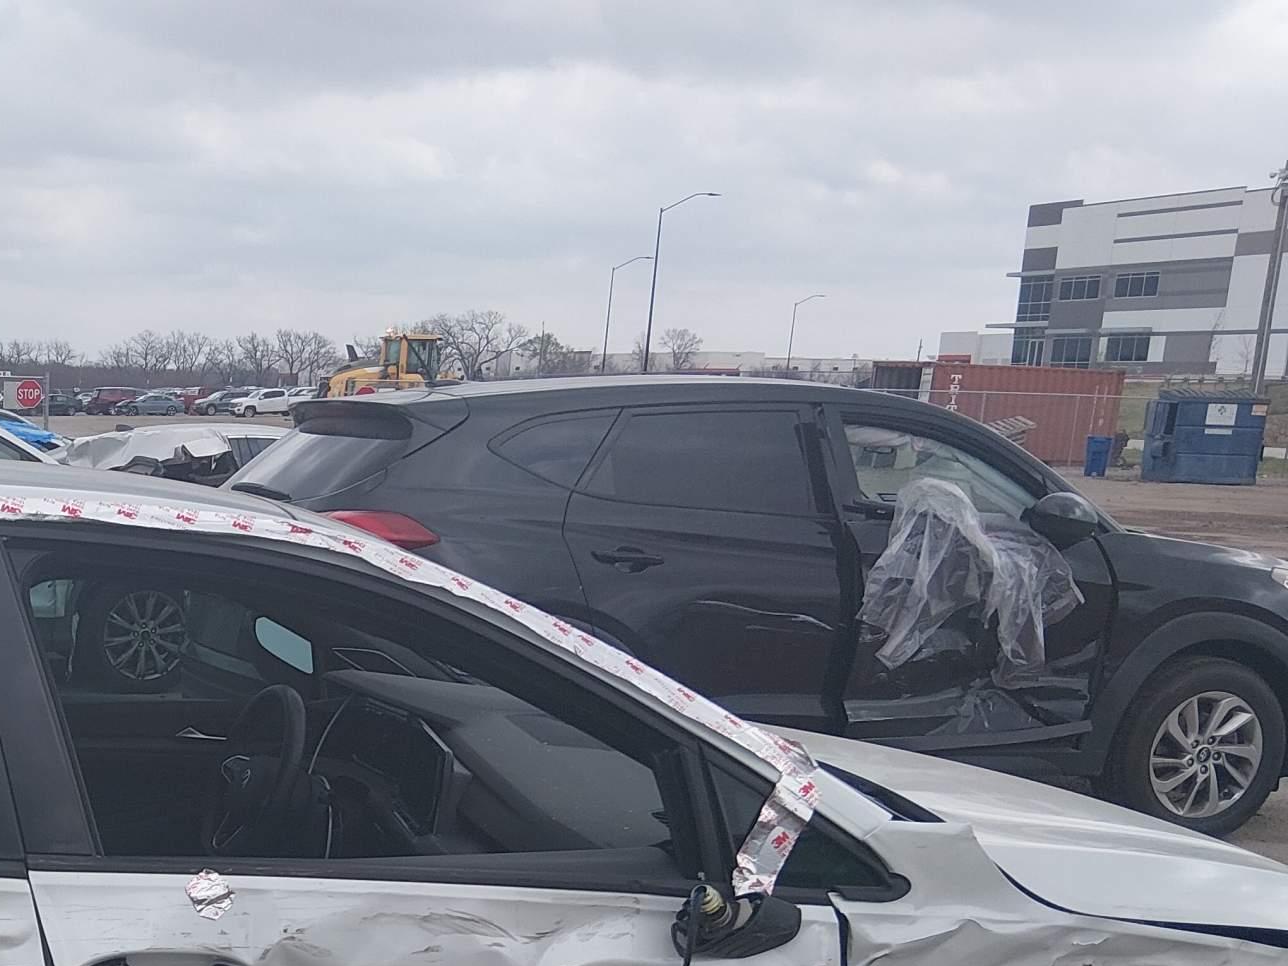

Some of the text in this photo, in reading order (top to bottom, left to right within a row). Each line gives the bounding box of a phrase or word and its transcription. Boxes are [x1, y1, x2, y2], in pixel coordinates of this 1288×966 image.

[17, 388, 40, 400] STOP
[61, 504, 83, 518] 3M
[116, 508, 138, 520] 3M
[176, 512, 198, 526] 3M
[232, 519, 253, 533] 3M
[798, 781, 816, 798] 3M
[770, 831, 790, 850] 3M
